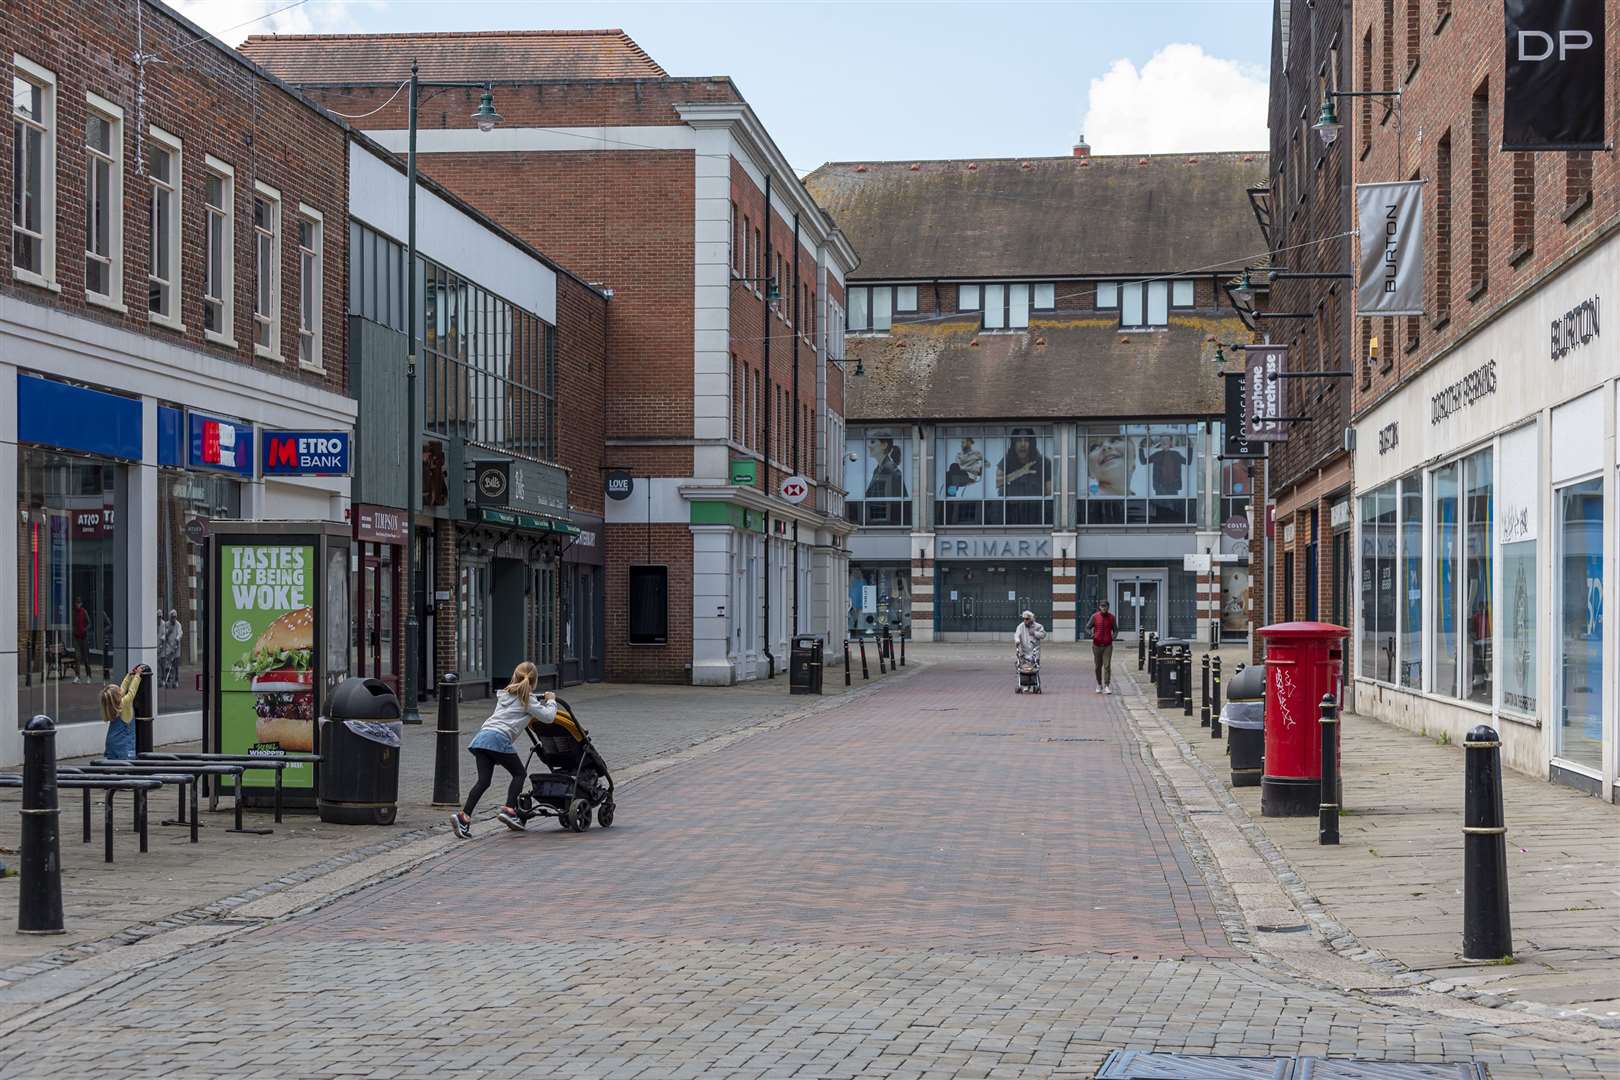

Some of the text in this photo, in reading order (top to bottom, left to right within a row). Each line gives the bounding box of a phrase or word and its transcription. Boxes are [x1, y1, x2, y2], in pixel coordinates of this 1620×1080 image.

[1518, 29, 1593, 61] DP
[1384, 204, 1397, 293] BURTON
[1551, 293, 1600, 361] BURTON
[1251, 365, 1264, 432] Crphone
[268, 437, 342, 468] METRO
[300, 456, 342, 467] BANK
[374, 512, 399, 530] TIMPSON
[231, 547, 304, 569] TASTES
[941, 540, 1049, 557] PRIMARK
[231, 569, 304, 586] OF BEING
[231, 585, 305, 610] WOKE
